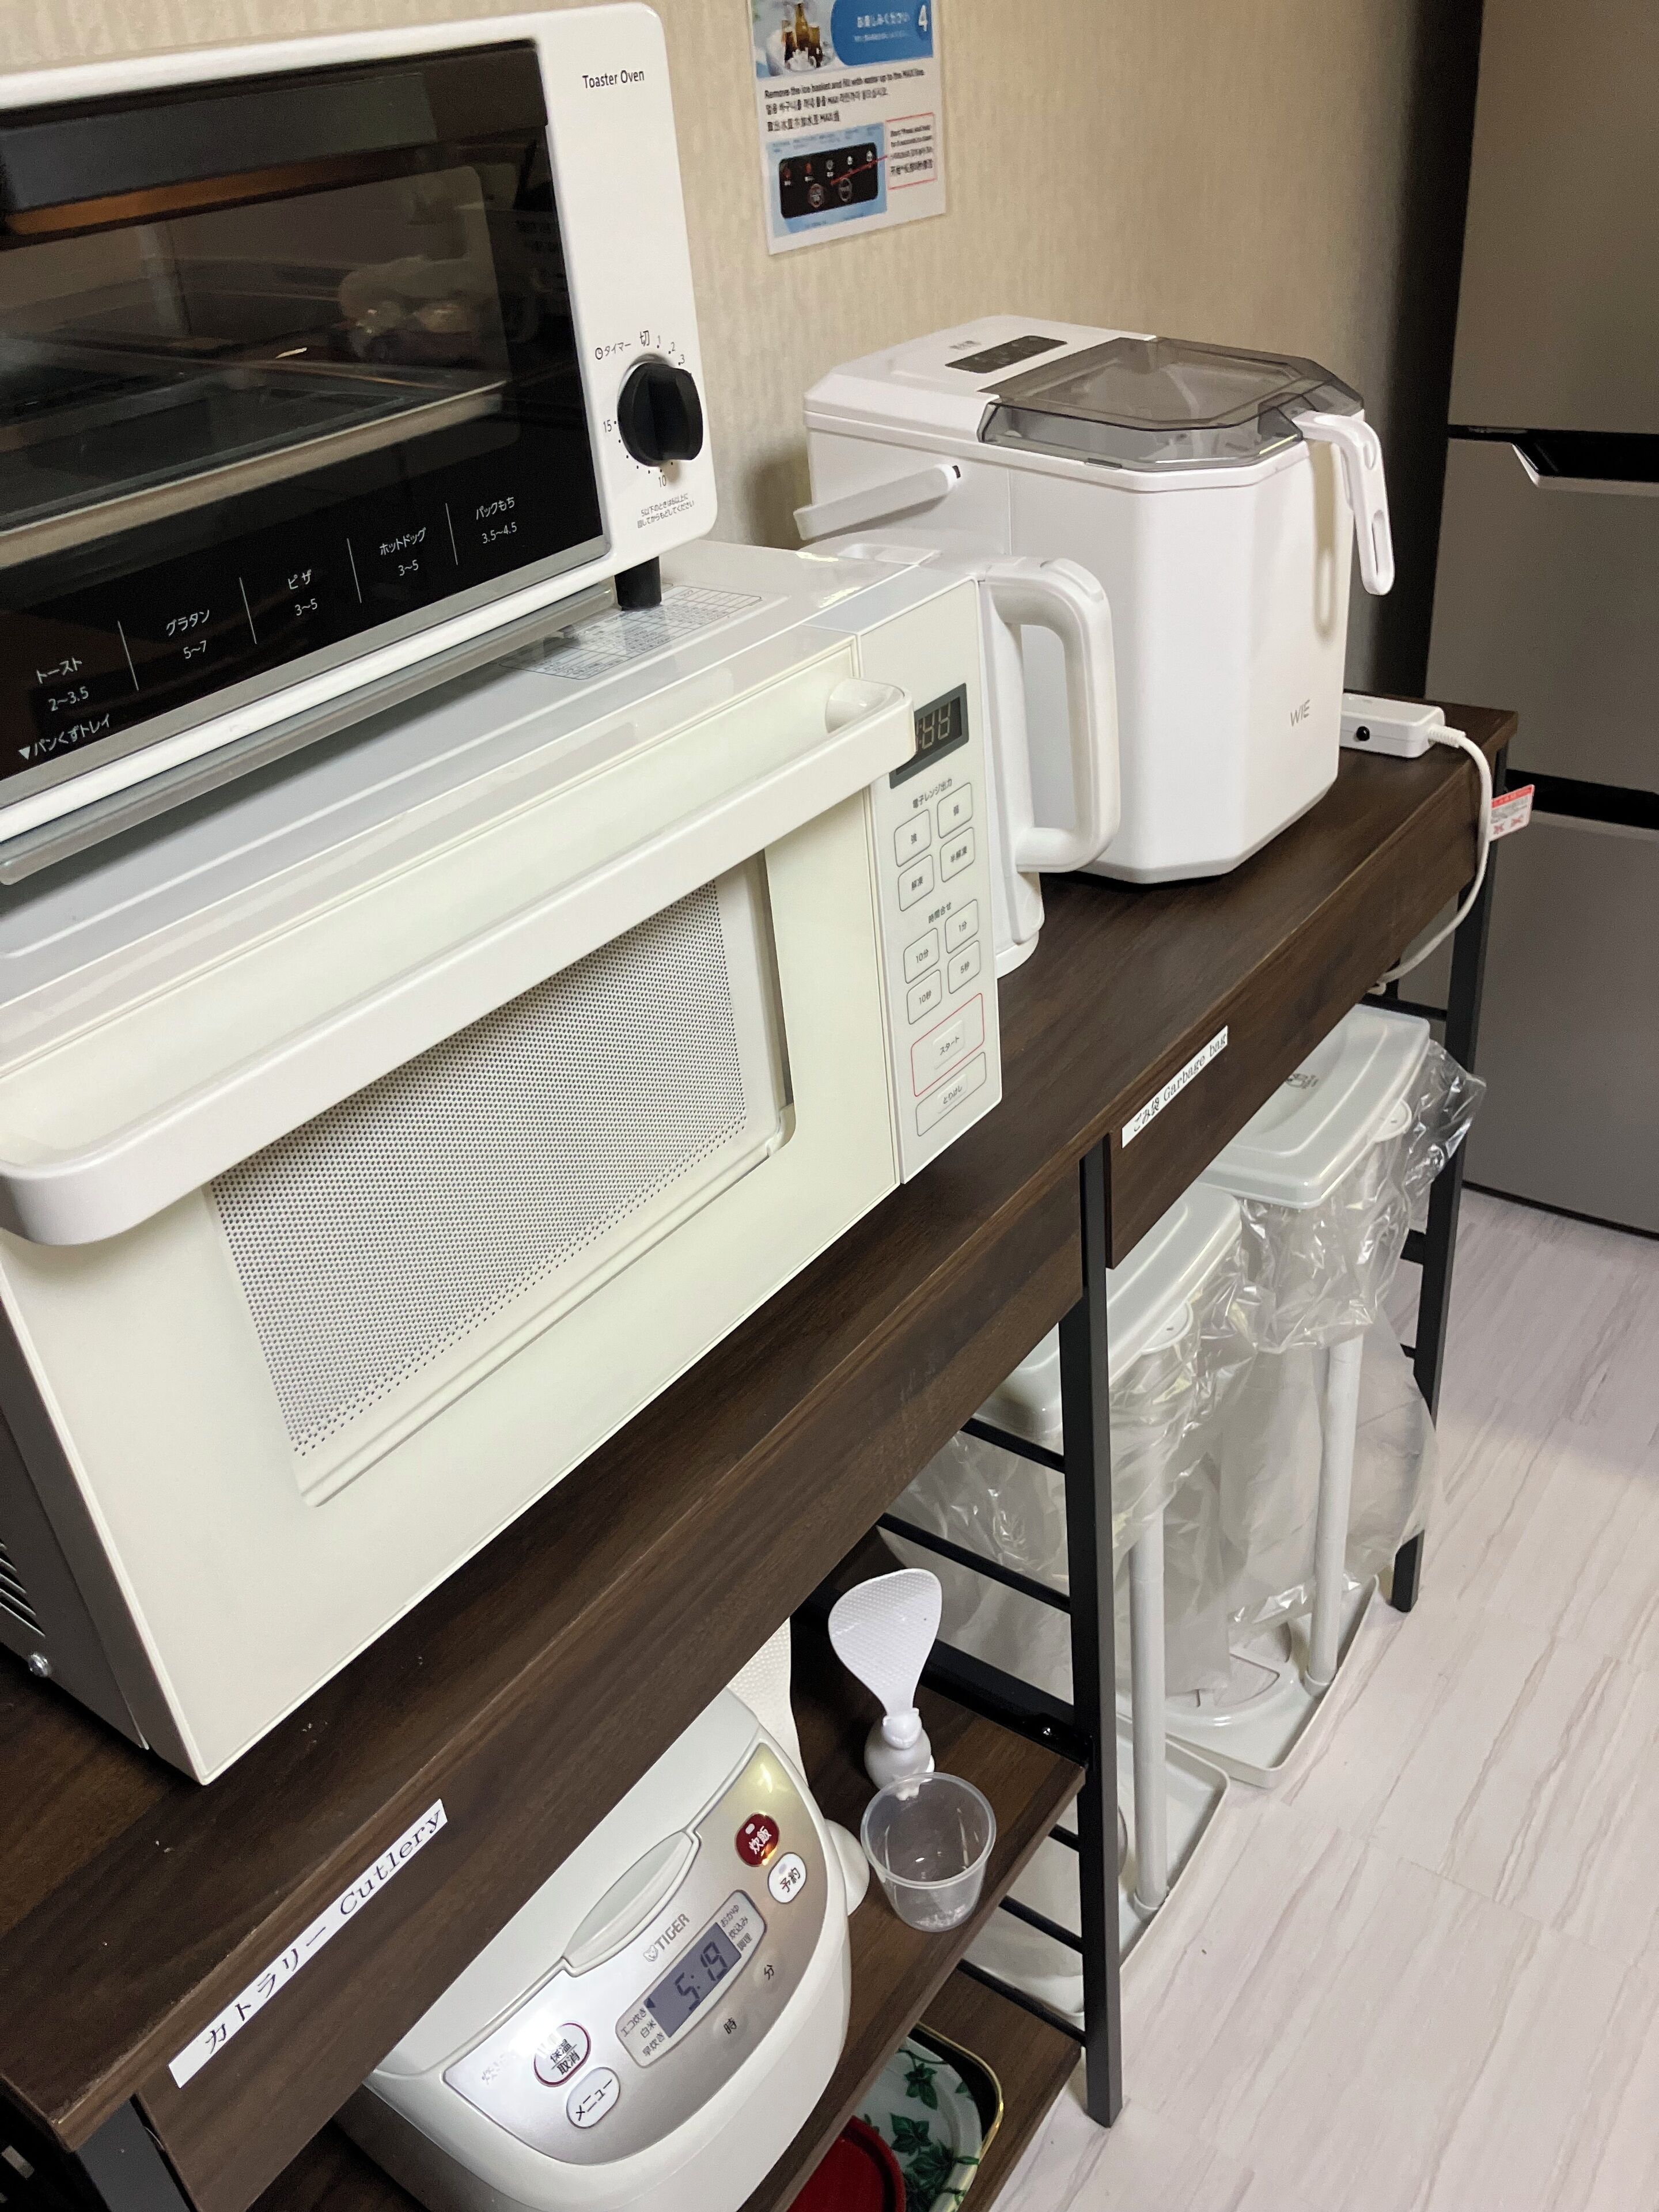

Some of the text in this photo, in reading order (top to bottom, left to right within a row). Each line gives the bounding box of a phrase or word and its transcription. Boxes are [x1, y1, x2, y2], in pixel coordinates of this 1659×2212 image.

[918, 5, 927, 32] 4
[582, 69, 645, 89] Toaster Oven
[604, 342, 632, 358] タイマー
[639, 329, 650, 347] 切
[670, 341, 676, 352] 2
[680, 355, 685, 364] 3
[603, 419, 613, 433] 15
[658, 474, 667, 488] 10
[475, 496, 516, 521] パックもち
[379, 527, 427, 557] ホットドッグ
[288, 569, 313, 591] ピザ
[166, 608, 211, 636] グラタン
[37, 657, 83, 684] トースト
[915, 949, 929, 964] 10分
[918, 990, 932, 1005] 10秒
[939, 1036, 960, 1056] スタート
[942, 1084, 963, 1105] とりけし
[1134, 1033, 1226, 1132] ごみ袋 Garbage bag
[748, 1826, 772, 1854] 炊飯
[779, 1866, 802, 1893] 予約
[720, 1904, 740, 1928] おかゆ
[205, 1809, 441, 2054] カトラリー Cutlery
[653, 1912, 691, 1950] TIGER
[728, 1916, 749, 1941] 炊込み
[674, 1941, 728, 2012] 5:19
[763, 1964, 776, 1979] 分
[621, 2009, 647, 2037] エコ炊き
[640, 2019, 657, 2039] 白米
[723, 2017, 738, 2035] 時
[550, 2038, 573, 2064] 保温
[642, 2033, 665, 2056] 早炊き
[556, 2050, 581, 2075] 取消
[575, 2078, 613, 2122] メニュー
